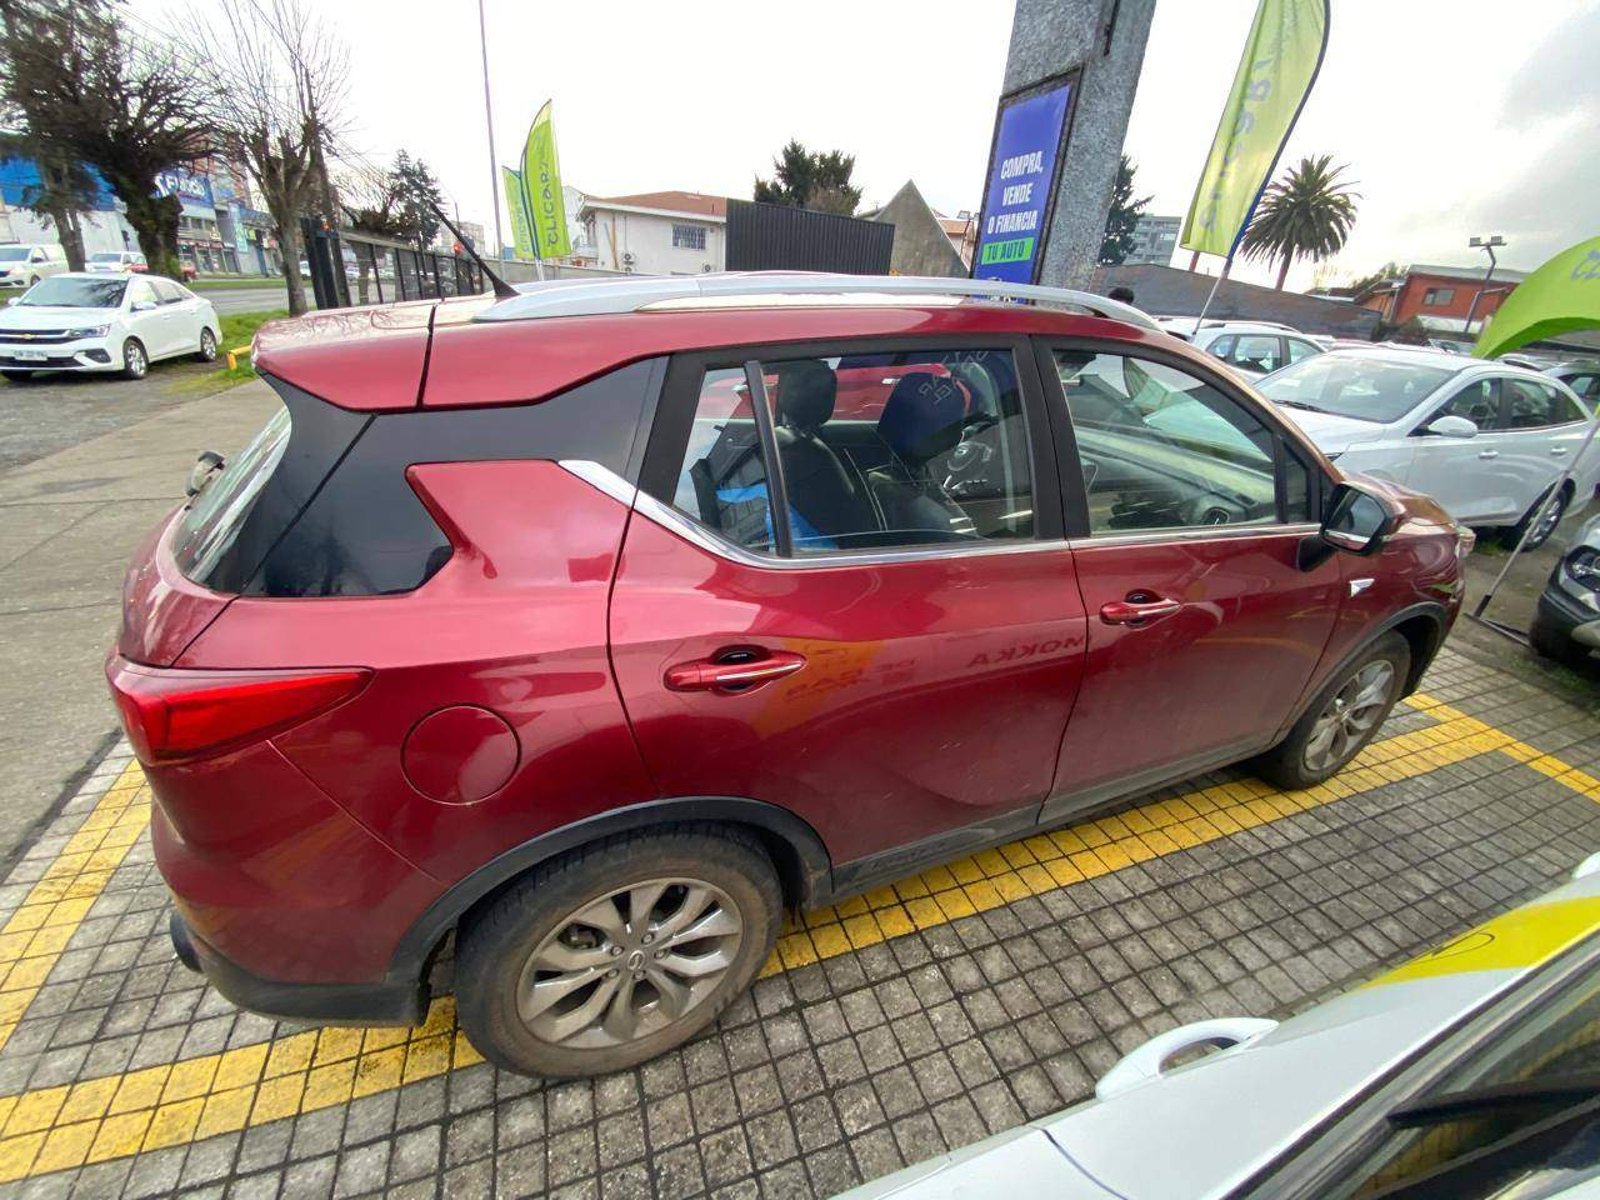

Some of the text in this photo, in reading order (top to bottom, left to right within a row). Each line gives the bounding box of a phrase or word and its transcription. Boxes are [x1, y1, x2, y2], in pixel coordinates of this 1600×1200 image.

[1001, 151, 1043, 179] COMPRA,
[1002, 183, 1033, 207] VENDE
[987, 210, 1038, 234] O FINANCIA
[988, 241, 1026, 261] TU AUTO
